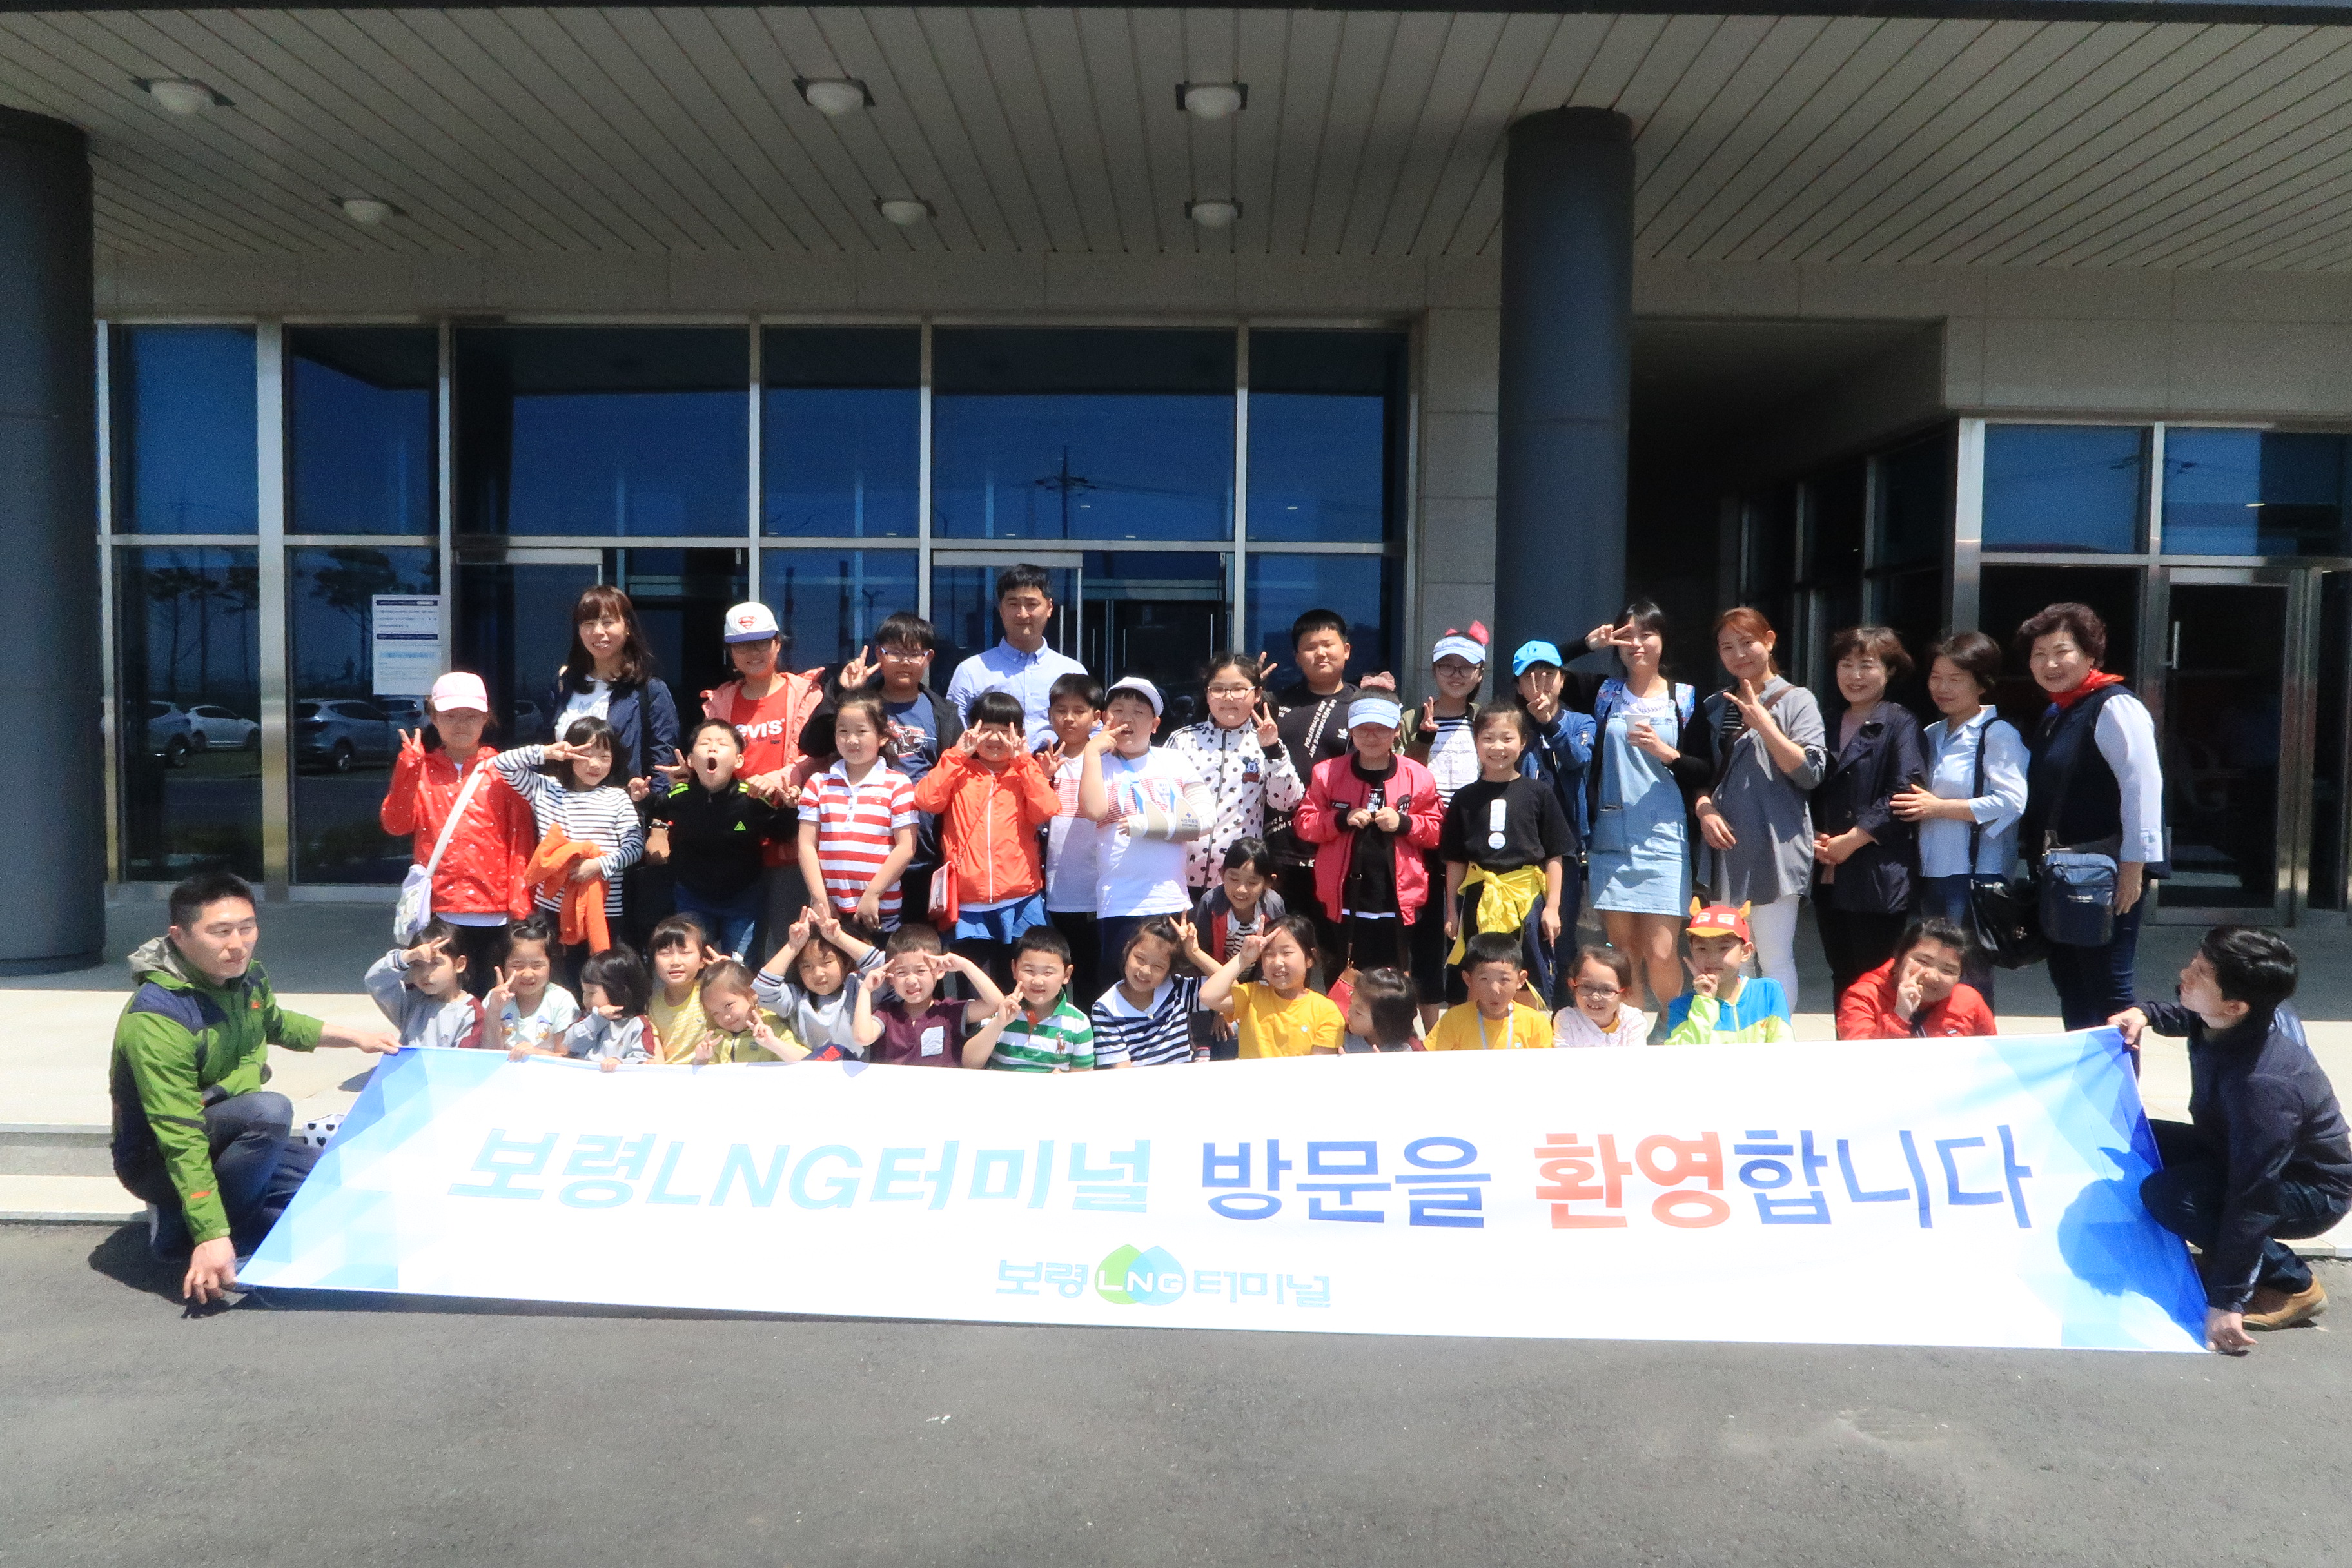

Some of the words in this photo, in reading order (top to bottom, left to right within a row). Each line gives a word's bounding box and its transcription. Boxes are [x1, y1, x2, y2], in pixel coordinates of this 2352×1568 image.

[447, 1129, 1151, 1213] 보령LNG터미널
[1202, 1136, 1491, 1228] 방문을
[1534, 1125, 2032, 1229] 환영합니다
